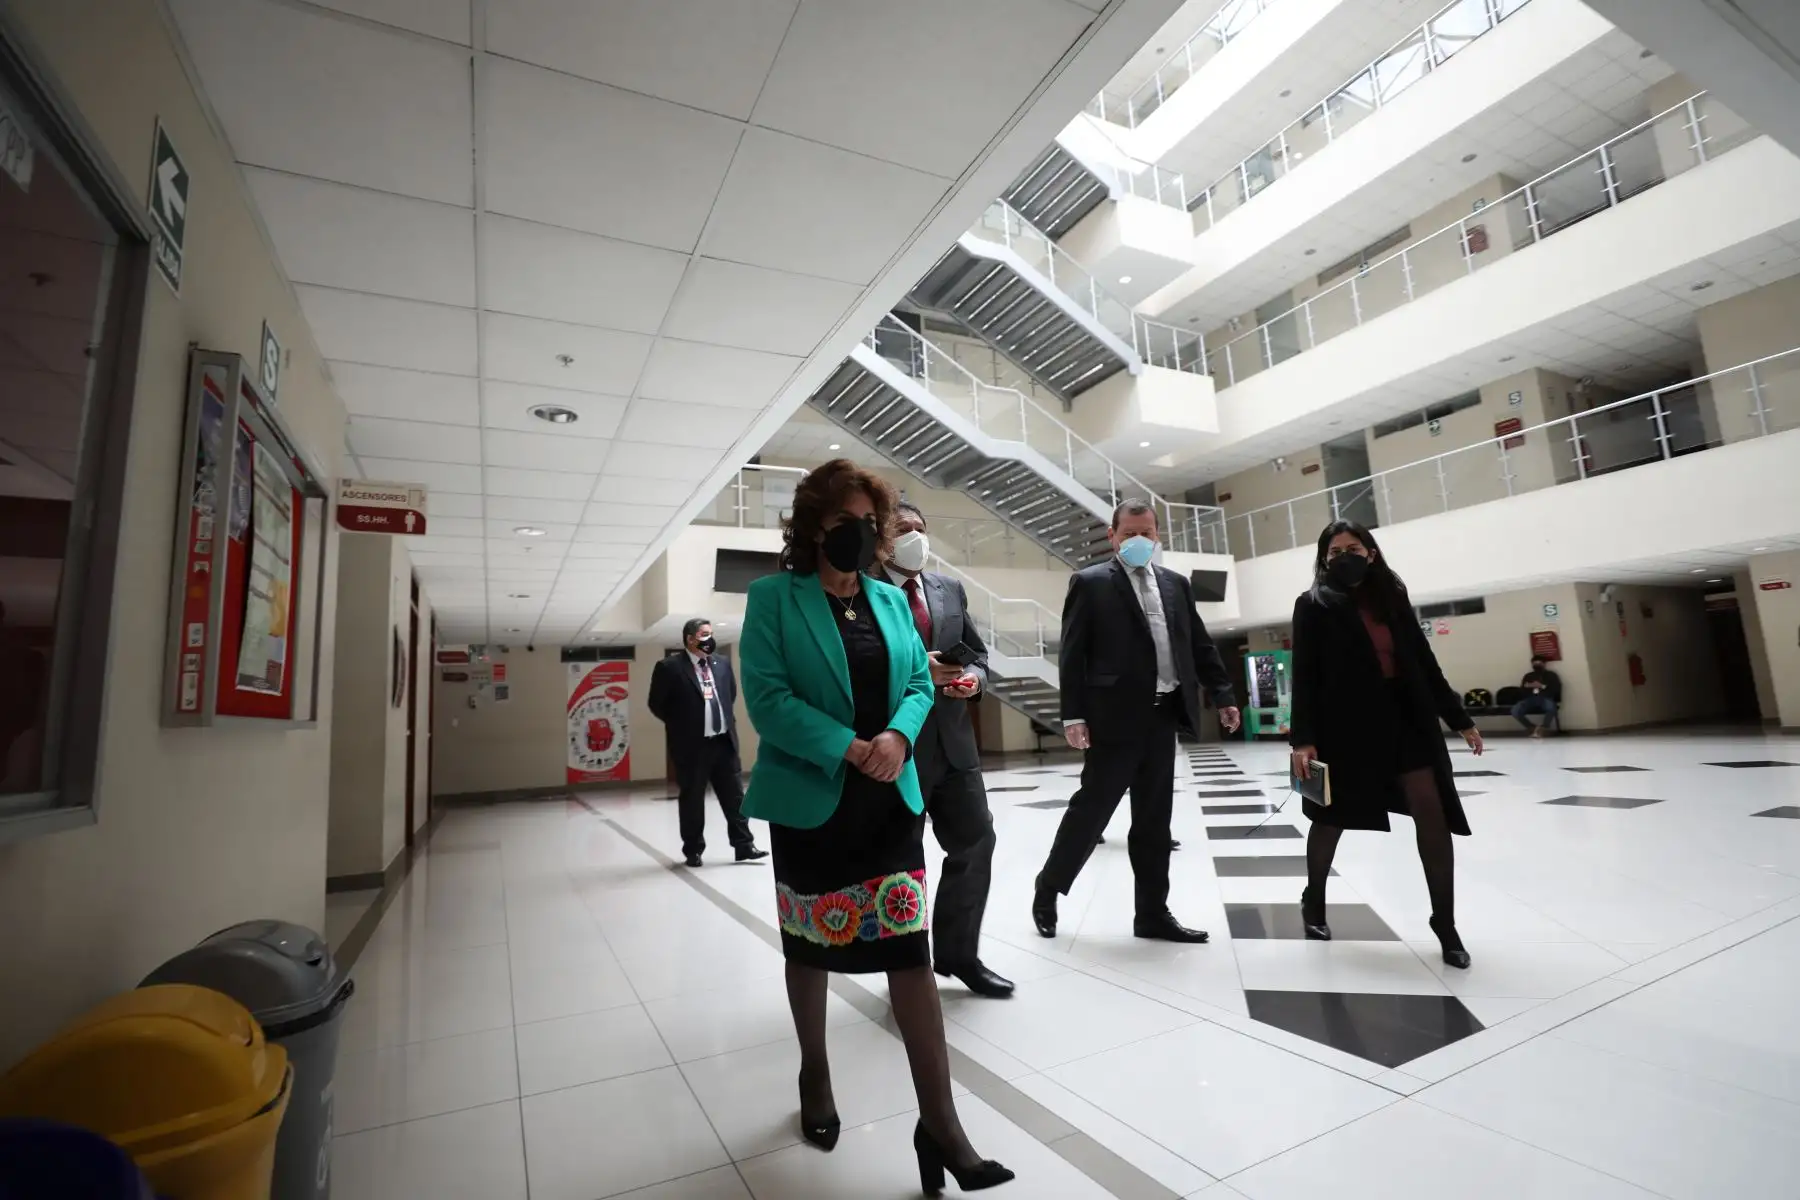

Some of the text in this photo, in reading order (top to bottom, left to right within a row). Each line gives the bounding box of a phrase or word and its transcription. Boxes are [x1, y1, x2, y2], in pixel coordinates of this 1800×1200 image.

[264, 338, 278, 391] S
[1510, 393, 1521, 403] S
[342, 491, 407, 503] ASCENSORES
[357, 514, 390, 524] SS.HH.
[1545, 605, 1557, 616] S
